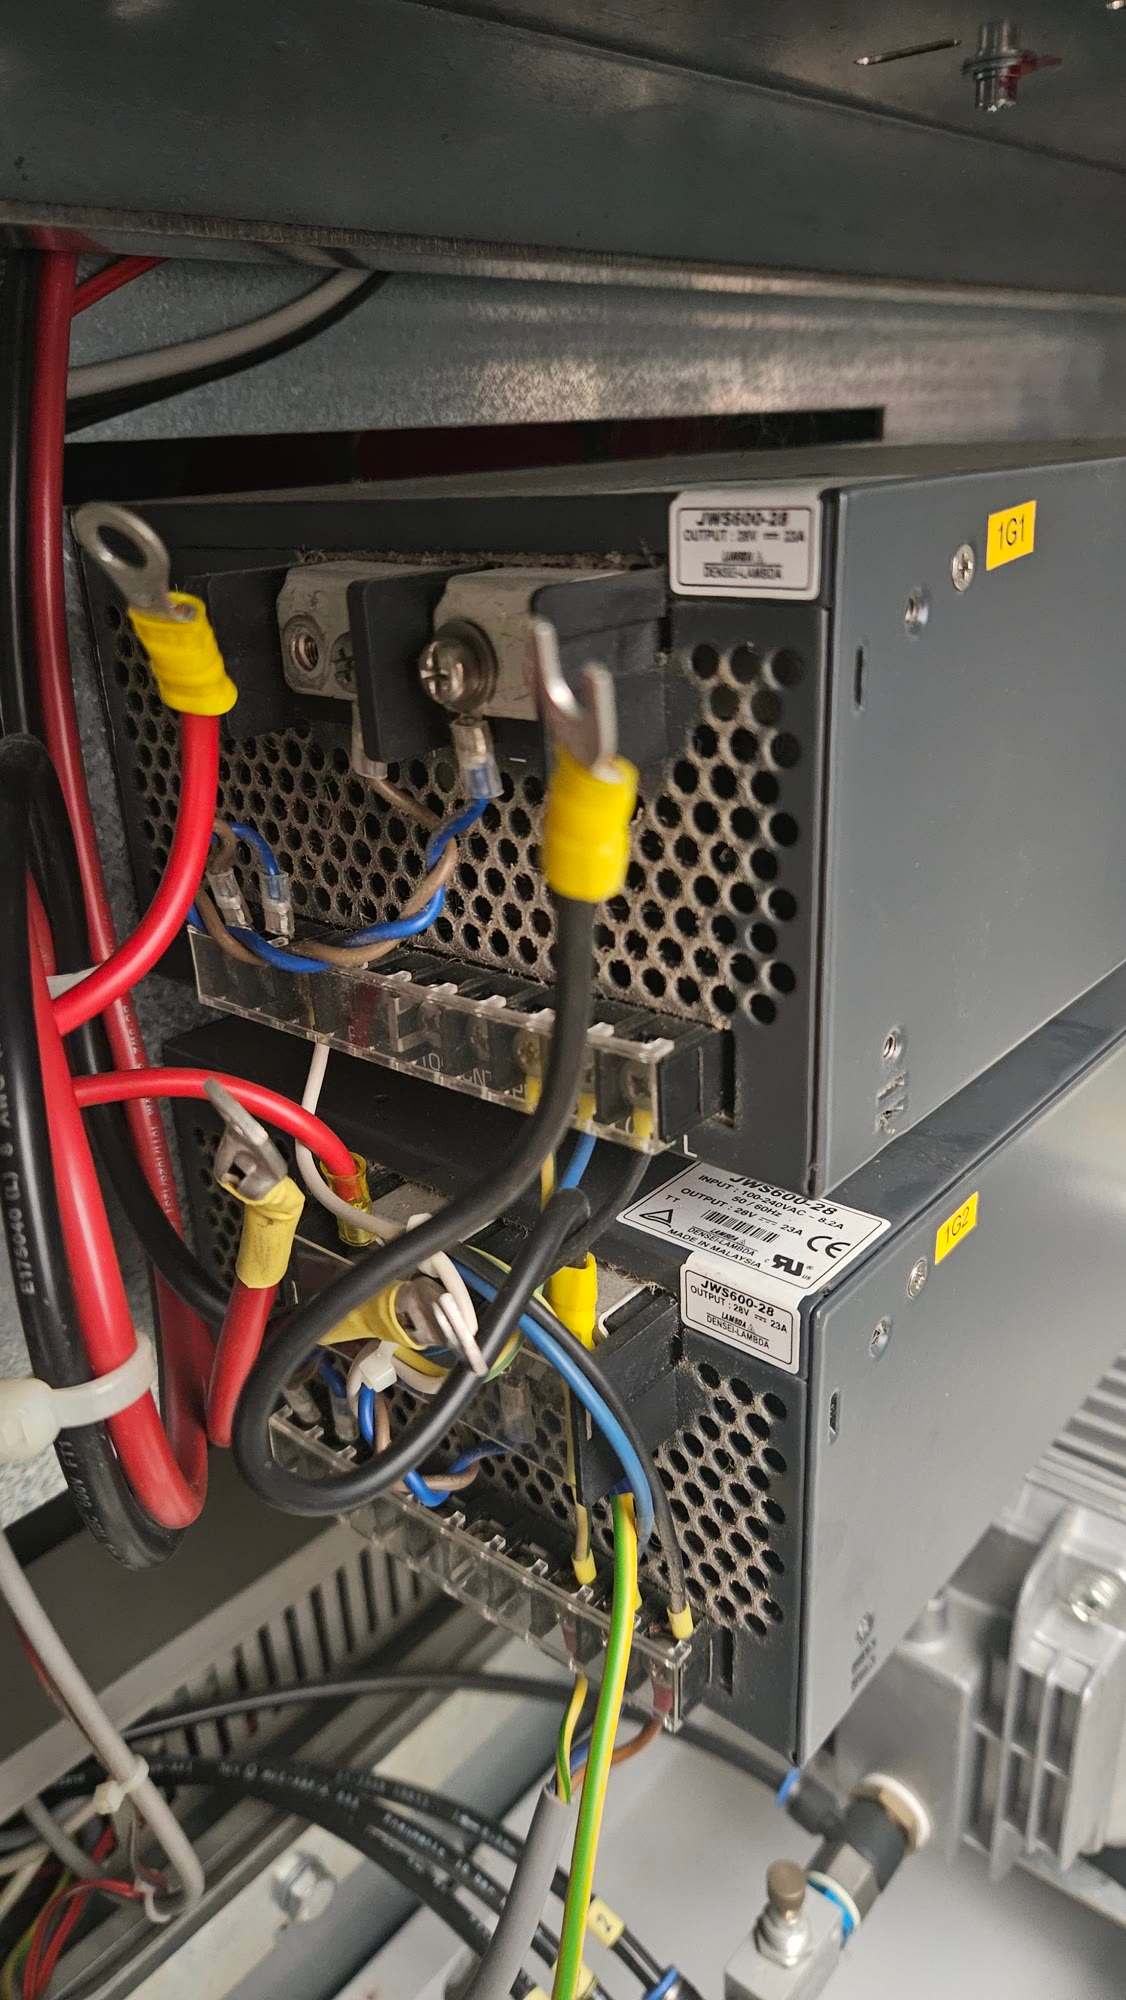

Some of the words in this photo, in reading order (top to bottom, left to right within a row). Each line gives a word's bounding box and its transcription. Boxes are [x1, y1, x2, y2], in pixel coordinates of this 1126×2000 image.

[683, 529, 727, 542] OUTPUT
[696, 512, 788, 526] JWS600-28
[997, 514, 1025, 550] 1G1
[681, 1187, 728, 1207] OUTPUT
[733, 1207, 757, 1218] 28V
[780, 1224, 803, 1236] 23A
[698, 1174, 735, 1190] INPUT
[742, 1190, 807, 1217] 100-240VAC
[818, 1216, 844, 1230] 8.2A
[729, 1176, 837, 1215] JWS600-28
[731, 1196, 748, 1204] 50
[754, 1203, 782, 1218] 60Hz
[688, 1227, 755, 1257] DENSEI-LAMBDA
[944, 1206, 970, 1245] 1G2
[668, 1229, 698, 1242] MADE
[698, 1240, 710, 1248] IN
[710, 1245, 761, 1268] MALAYSIA
[690, 1285, 725, 1306] OUTPUT
[733, 1303, 750, 1316] 28V
[770, 1319, 787, 1333] 23A
[701, 1280, 774, 1317] JWS600-28
[706, 1315, 770, 1349] DENSEI-LAMBDA
[721, 1312, 747, 1328] LAMBDA
